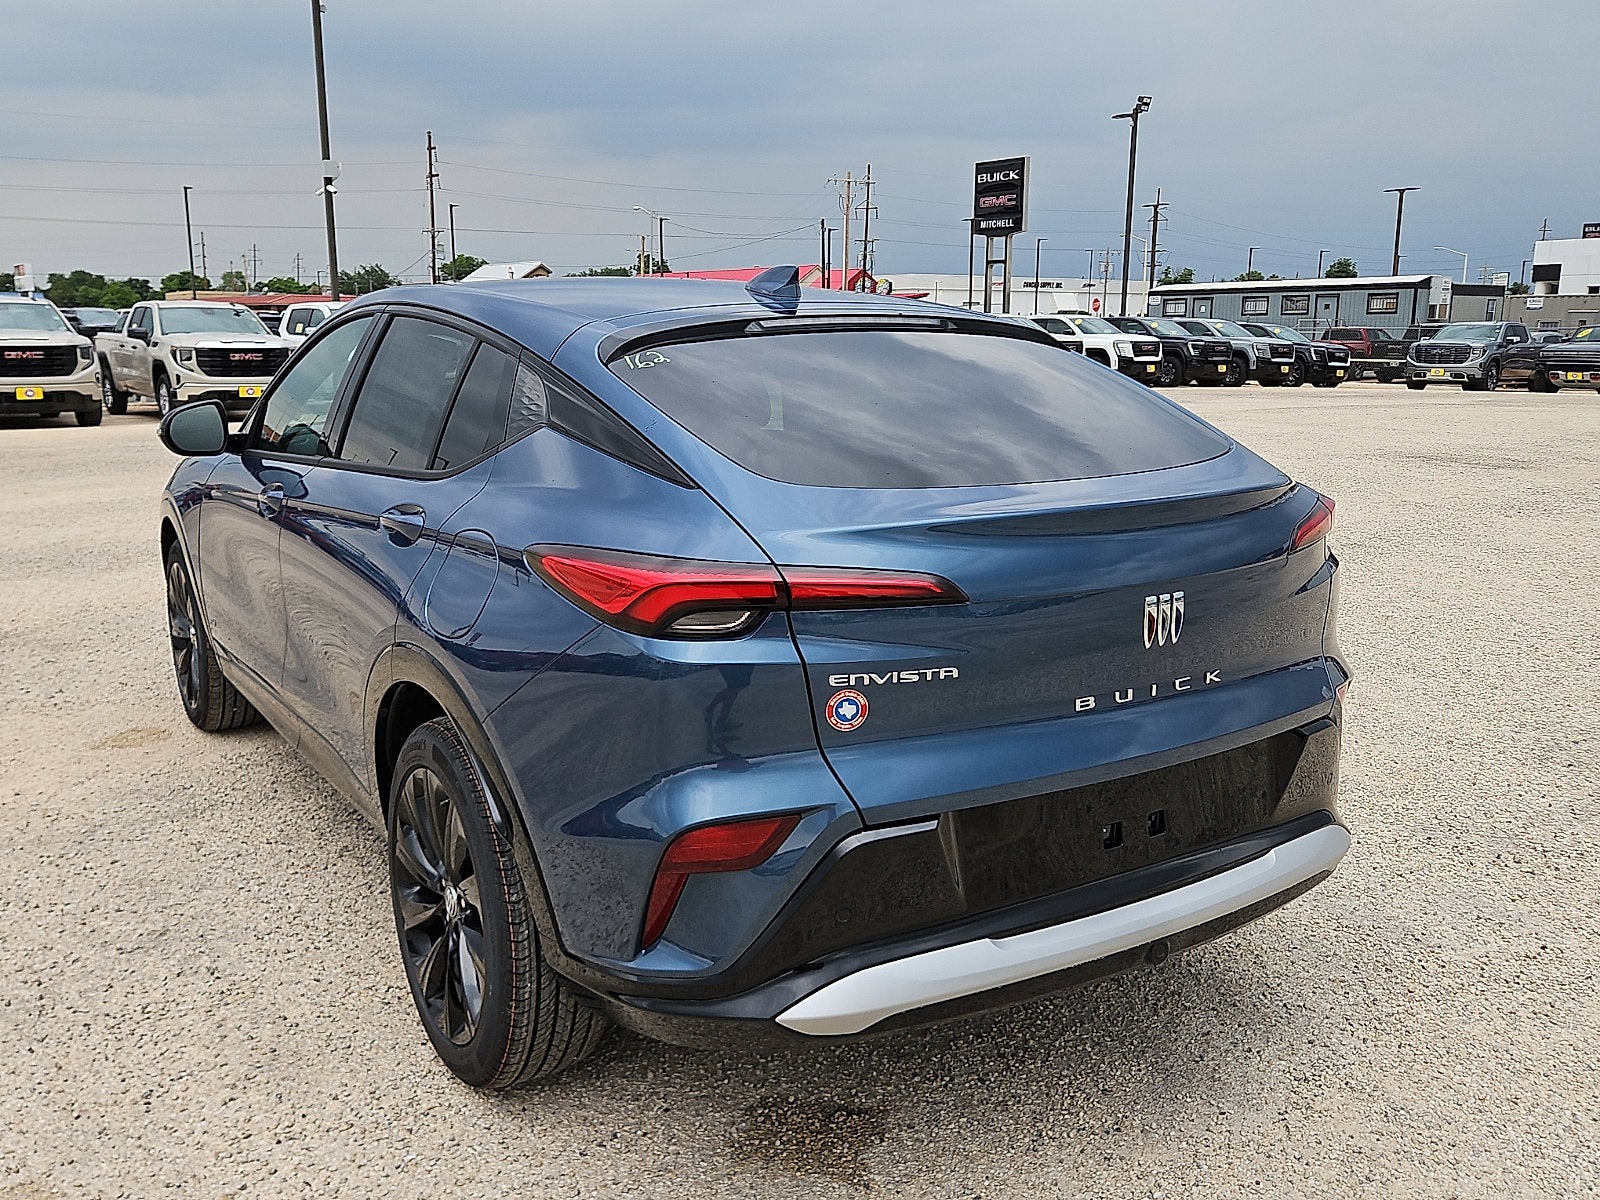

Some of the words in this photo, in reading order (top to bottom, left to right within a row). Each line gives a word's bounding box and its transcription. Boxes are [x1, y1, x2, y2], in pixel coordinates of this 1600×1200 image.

[977, 169, 1020, 183] BUICK
[979, 194, 1017, 208] GMC
[980, 218, 1014, 229] MITCHELL
[3, 351, 45, 359] GMC
[624, 351, 671, 370] 162
[828, 667, 959, 687] ENVISTA
[1075, 669, 1222, 712] BUICK
